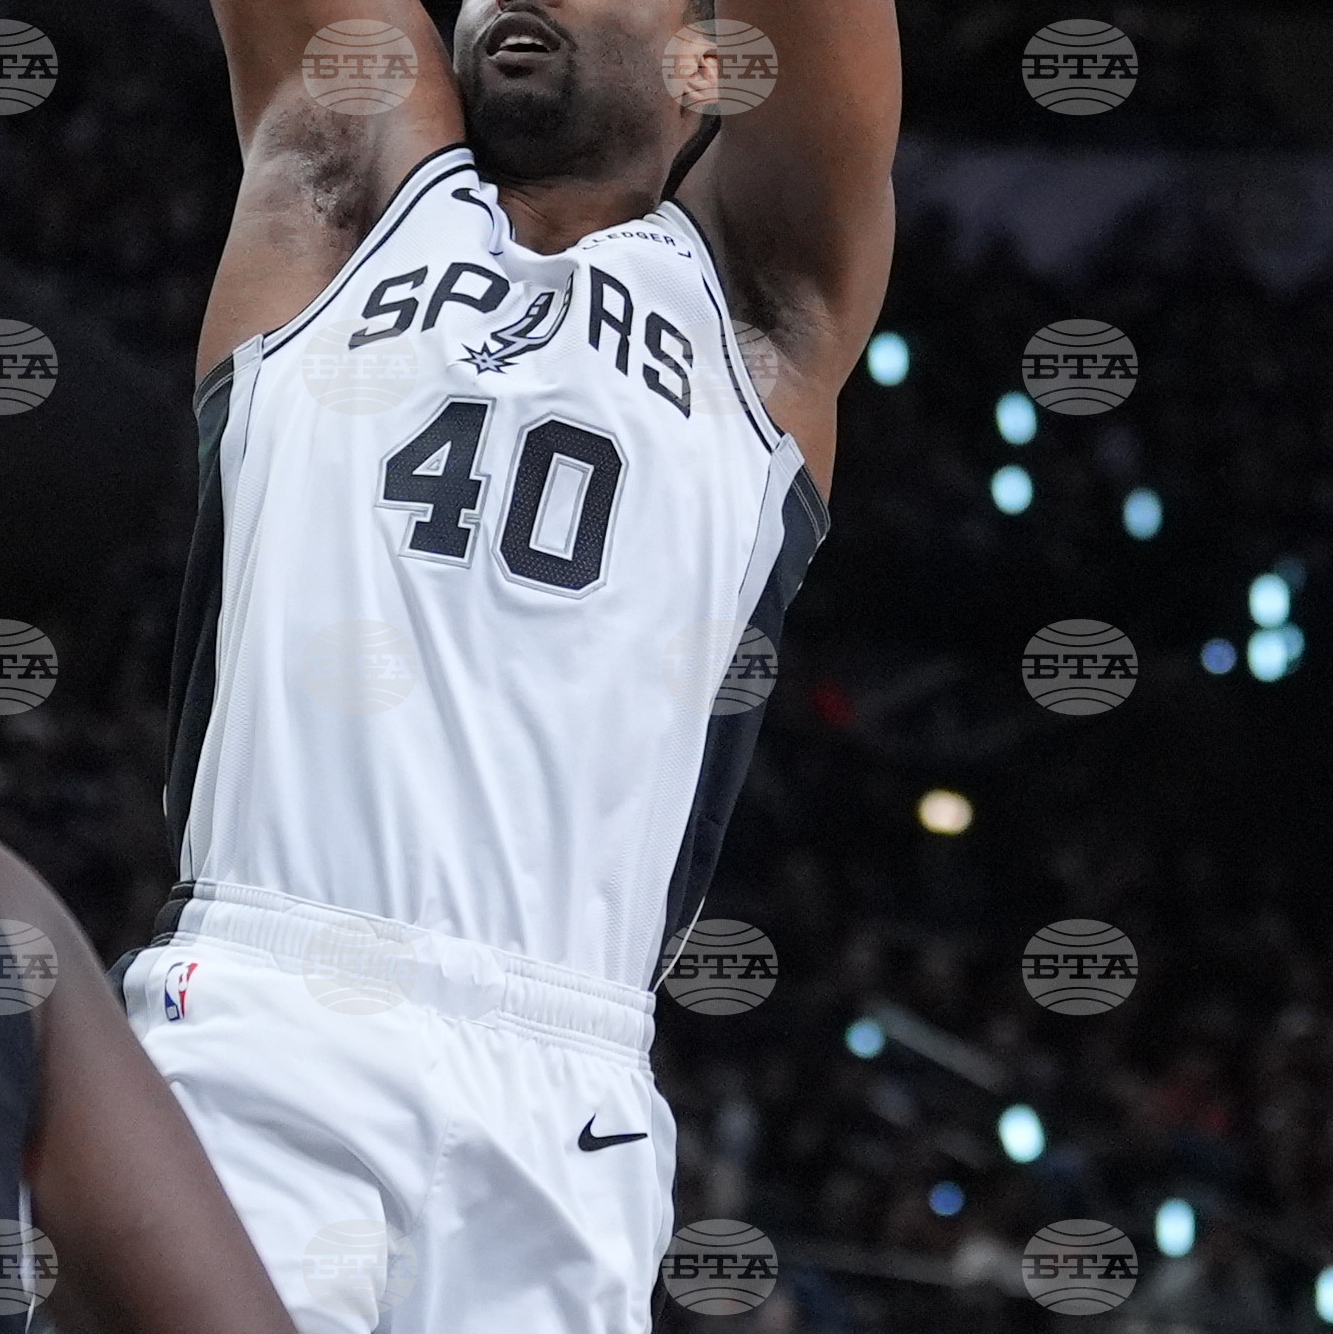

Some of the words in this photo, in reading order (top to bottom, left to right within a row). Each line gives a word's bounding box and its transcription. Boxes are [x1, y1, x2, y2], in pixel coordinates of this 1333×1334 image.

[592, 231, 676, 247] LEDGER
[348, 261, 694, 420] SPURS
[374, 394, 629, 600] 40
